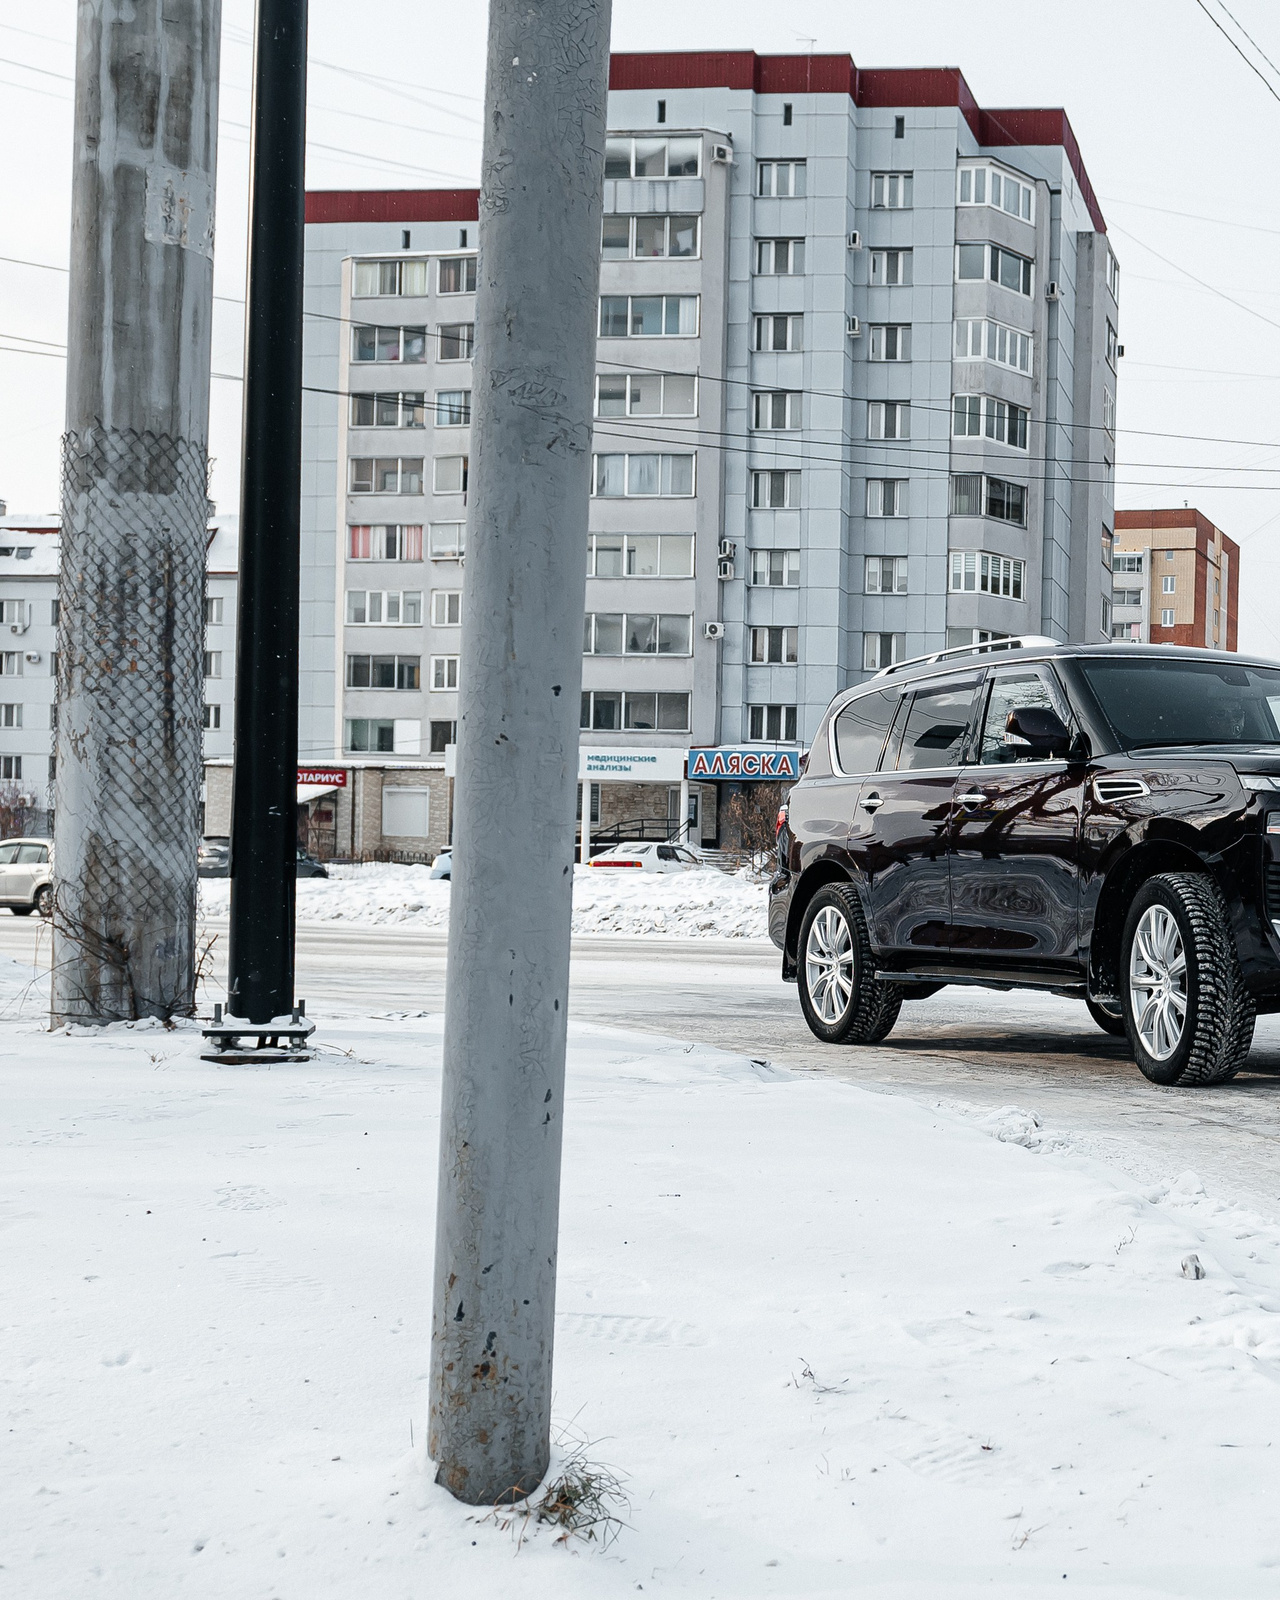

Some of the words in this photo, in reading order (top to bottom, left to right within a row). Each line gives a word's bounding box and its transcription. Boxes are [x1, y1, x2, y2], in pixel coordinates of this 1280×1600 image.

[587, 754, 657, 763] медицинские
[586, 764, 632, 772] анализы
[692, 753, 794, 775] АЛЯСКА
[297, 772, 344, 784] ОТАРИУС
